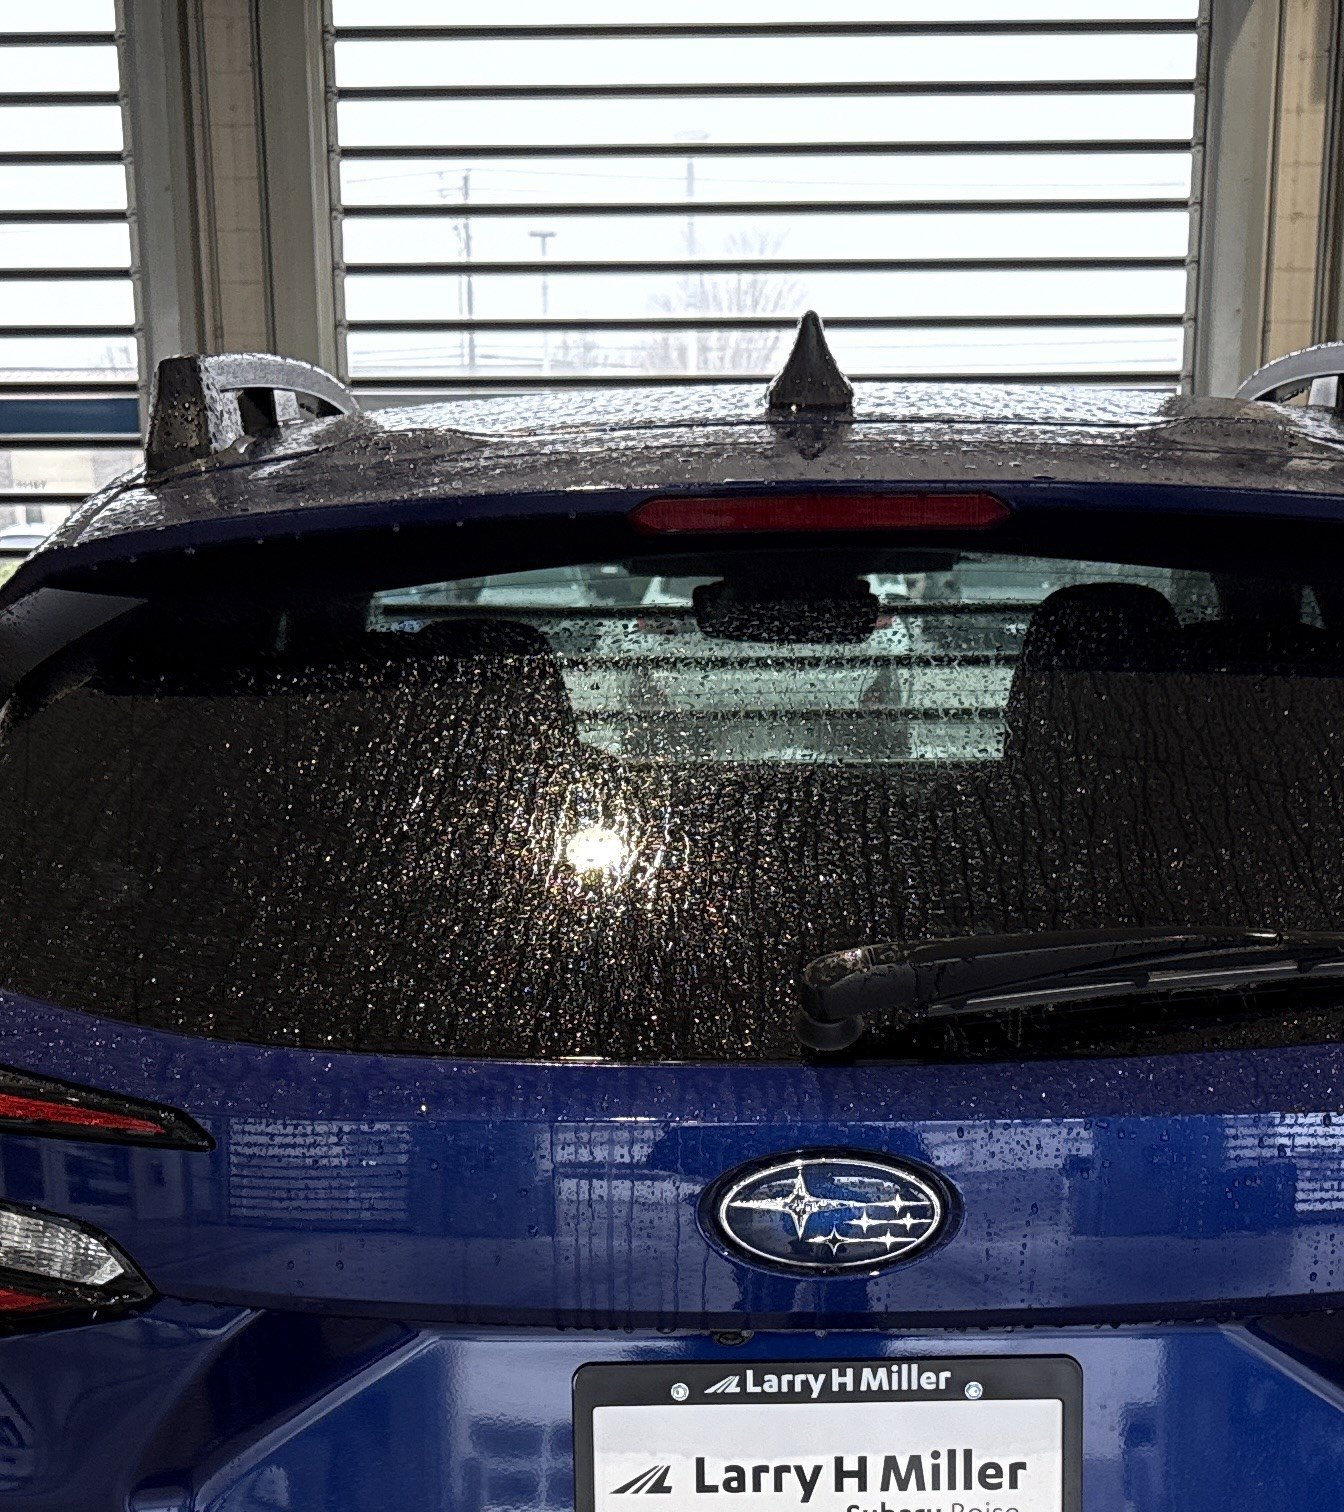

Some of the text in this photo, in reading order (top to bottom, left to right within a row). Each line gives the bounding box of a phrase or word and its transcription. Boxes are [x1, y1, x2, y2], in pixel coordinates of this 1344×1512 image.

[745, 1364, 952, 1398] Larry H Miller
[695, 1449, 1027, 1503] Larry H Miller
